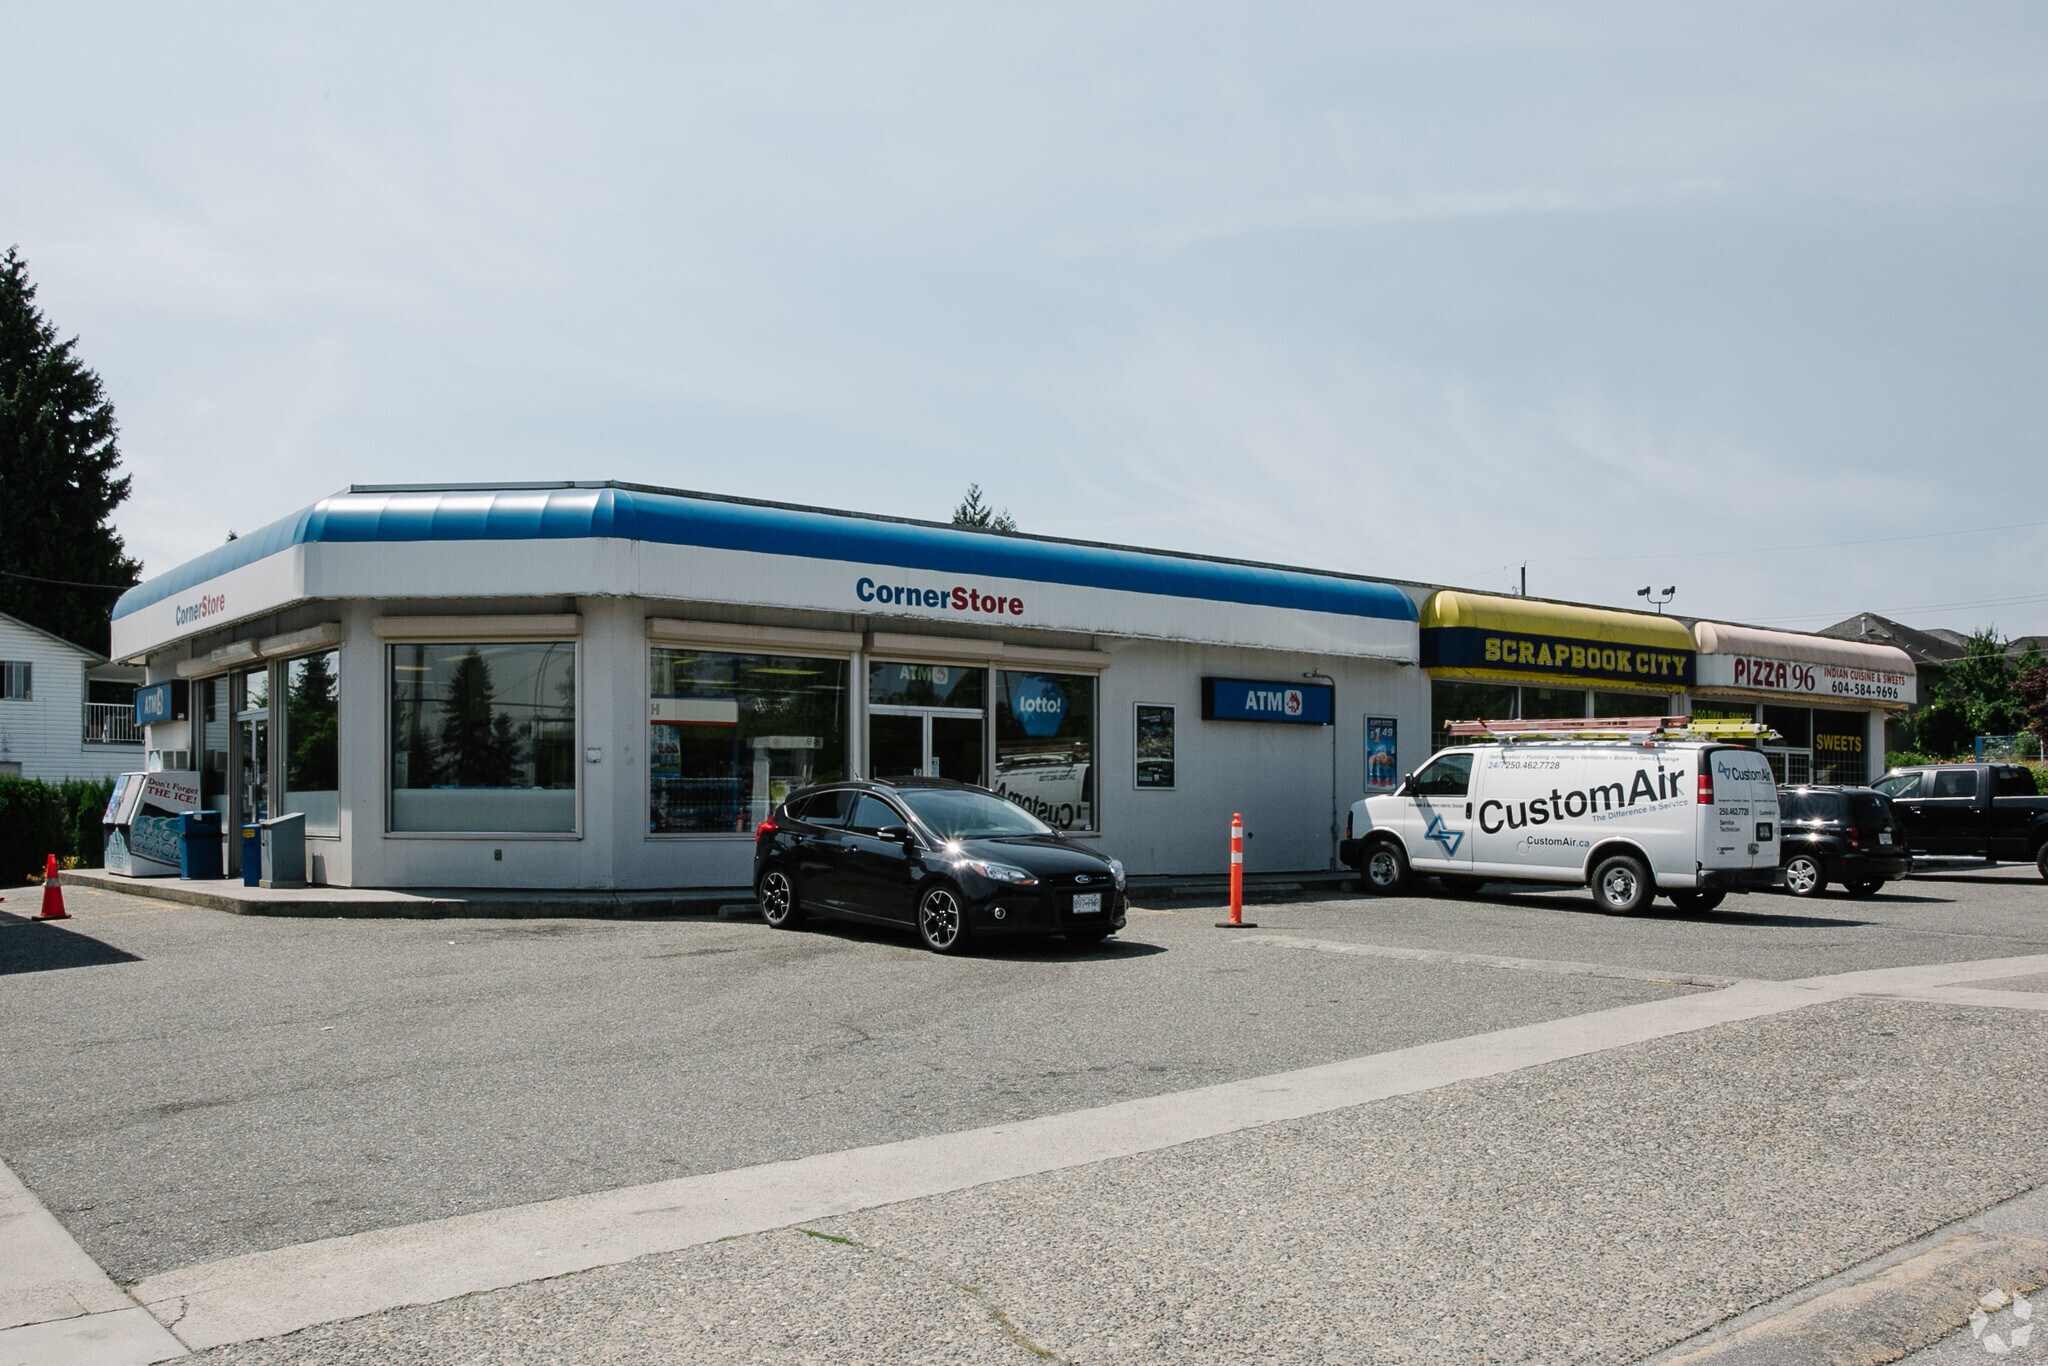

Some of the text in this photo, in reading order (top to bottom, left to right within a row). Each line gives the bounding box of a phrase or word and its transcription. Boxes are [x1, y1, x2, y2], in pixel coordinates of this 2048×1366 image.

[856, 577, 1024, 615] CornerStore
[176, 594, 225, 627] CornerStore
[1485, 637, 1687, 676] SCRAPBOOK CITY
[900, 665, 931, 681] ATM
[1734, 658, 1816, 691] PIZZA 96
[1824, 667, 1905, 686] INDIAN CUISINE & SWEETS
[1831, 680, 1899, 699] 604-584-9696
[144, 693, 157, 714] ATM
[1020, 696, 1061, 712] lotto!
[1245, 690, 1282, 711] ATM
[1816, 734, 1862, 752] SWEETS
[1506, 761, 1560, 769] 250.462.7728
[1732, 767, 1770, 781] CustomAir
[147, 786, 197, 804] THE ICE!
[148, 777, 198, 795] Don't Forget
[1479, 766, 1684, 834] CustomAir
[1608, 807, 1647, 819] Difference
[1658, 800, 1688, 810] Service
[1526, 836, 1590, 848] CustomAir.ca
